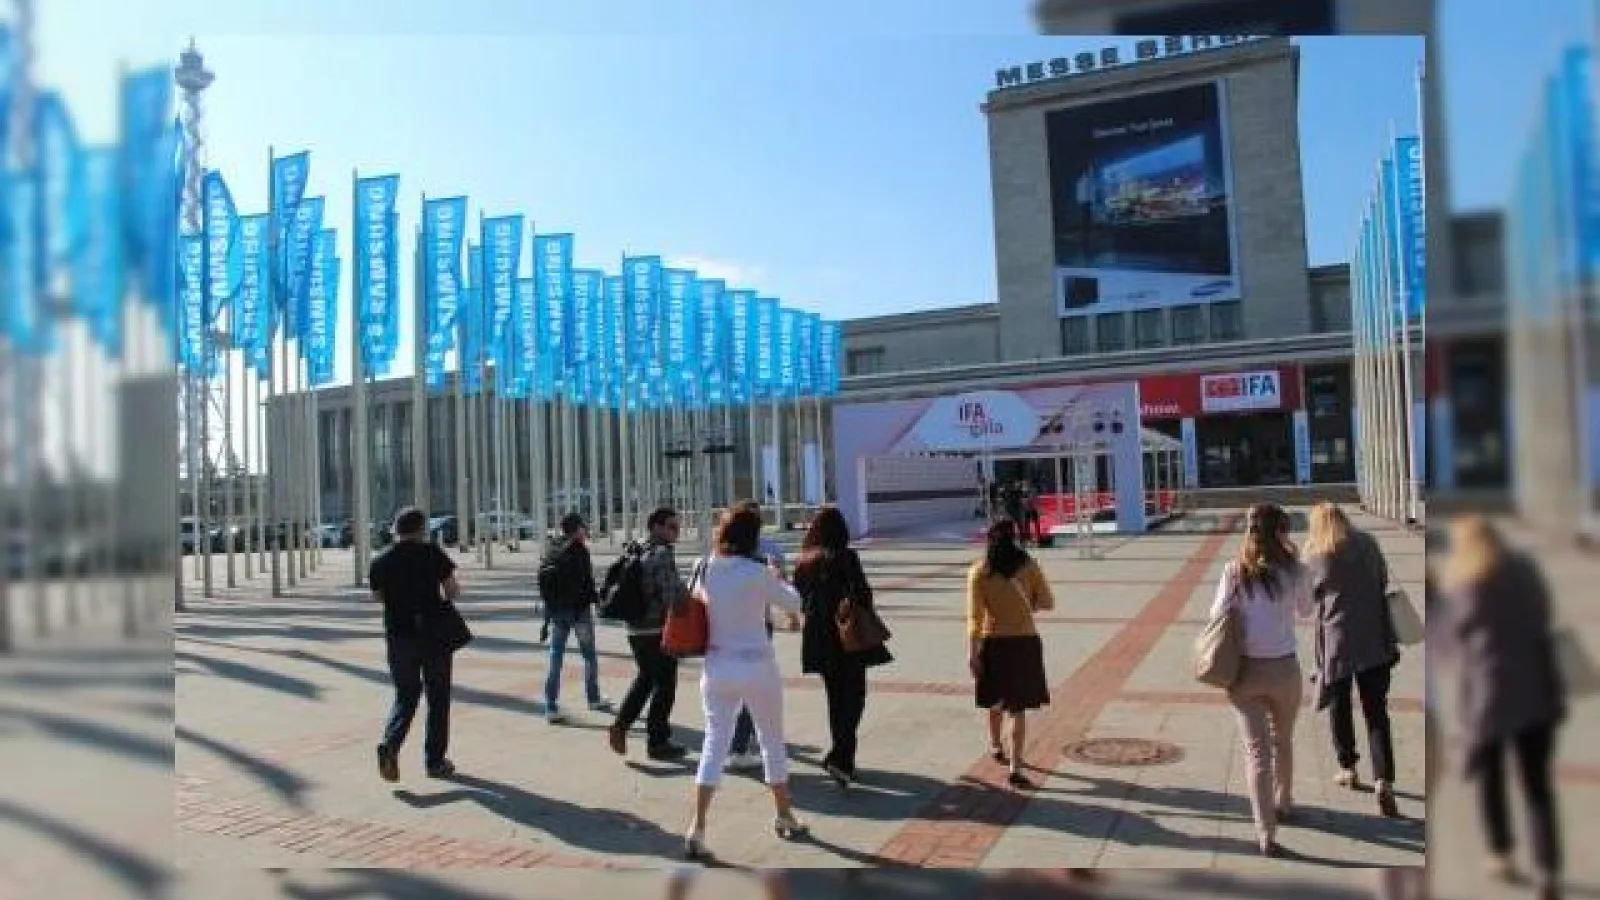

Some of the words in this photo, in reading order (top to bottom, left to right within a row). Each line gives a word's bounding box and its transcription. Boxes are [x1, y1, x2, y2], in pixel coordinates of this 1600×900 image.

[996, 47, 1121, 86] MESSE
[369, 186, 386, 315] SAMSUNG
[435, 204, 458, 328] SAMSUNG
[1241, 373, 1276, 397] IFA
[959, 402, 986, 423] IFA
